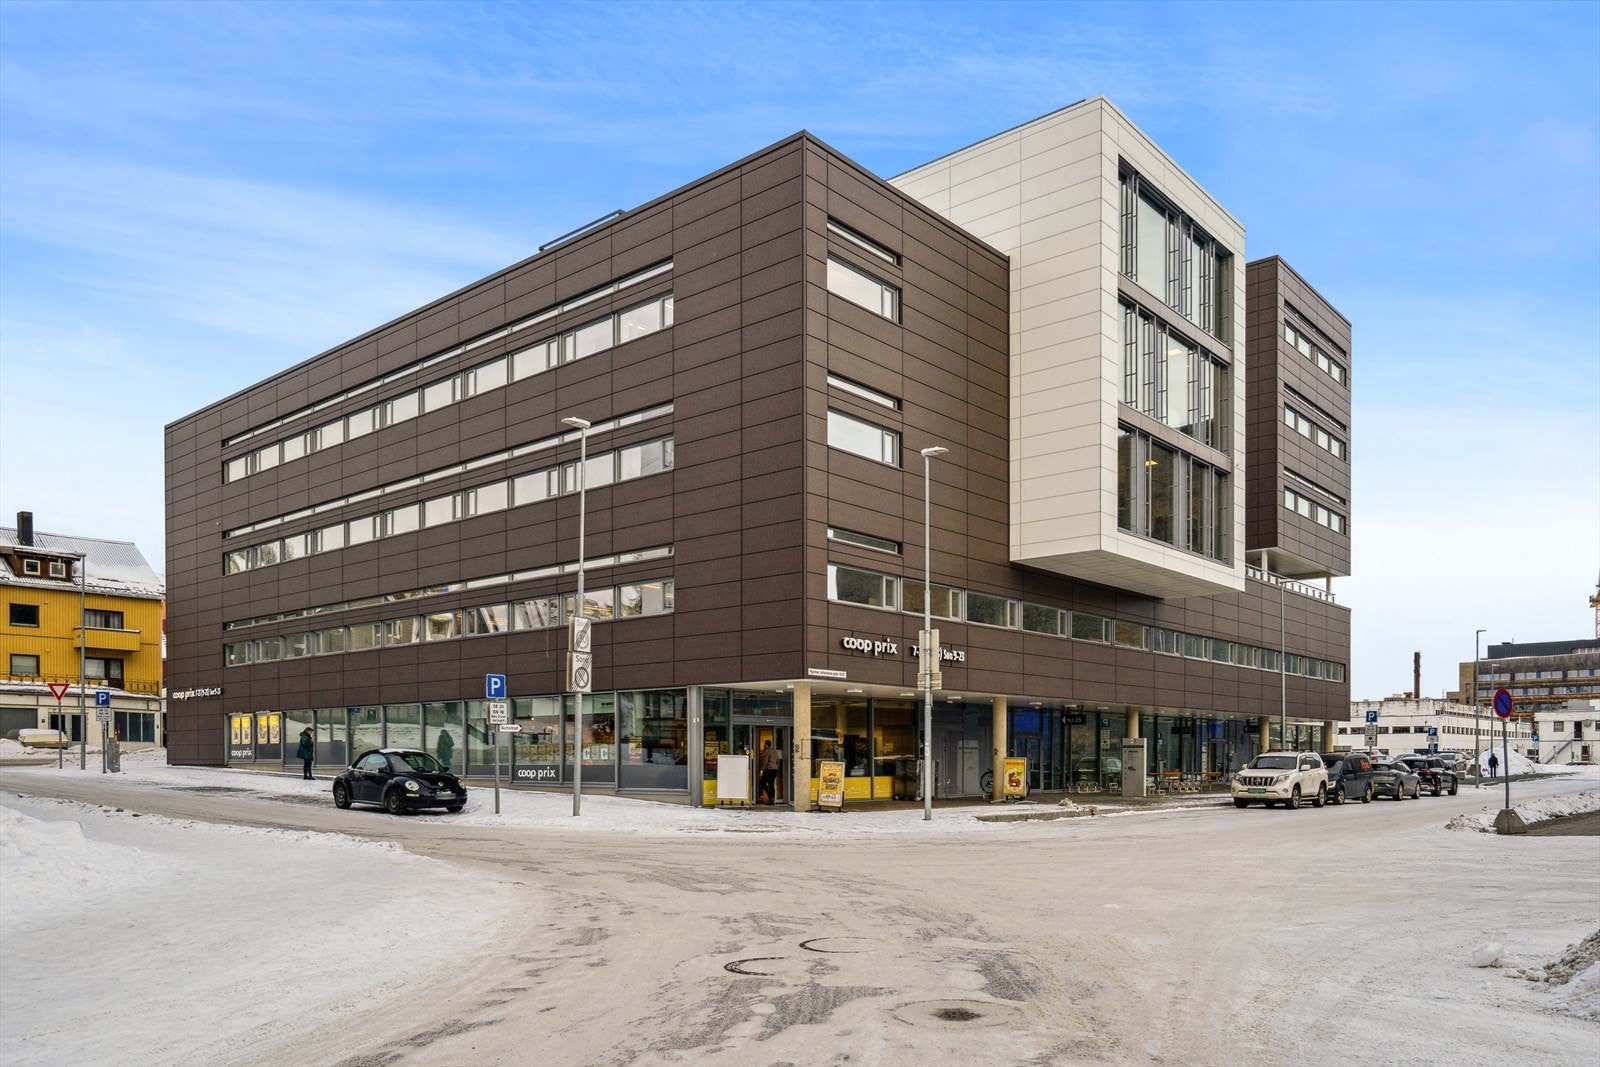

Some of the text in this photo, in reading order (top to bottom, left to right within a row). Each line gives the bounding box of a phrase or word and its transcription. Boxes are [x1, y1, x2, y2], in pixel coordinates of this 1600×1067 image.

[843, 636, 898, 656] coop prix
[491, 677, 501, 695] P
[99, 693, 107, 704] P
[172, 691, 184, 700] coop
[184, 687, 195, 700] prix
[1368, 712, 1375, 721] P
[242, 747, 253, 758] prix
[518, 766, 556, 780] coop prix
